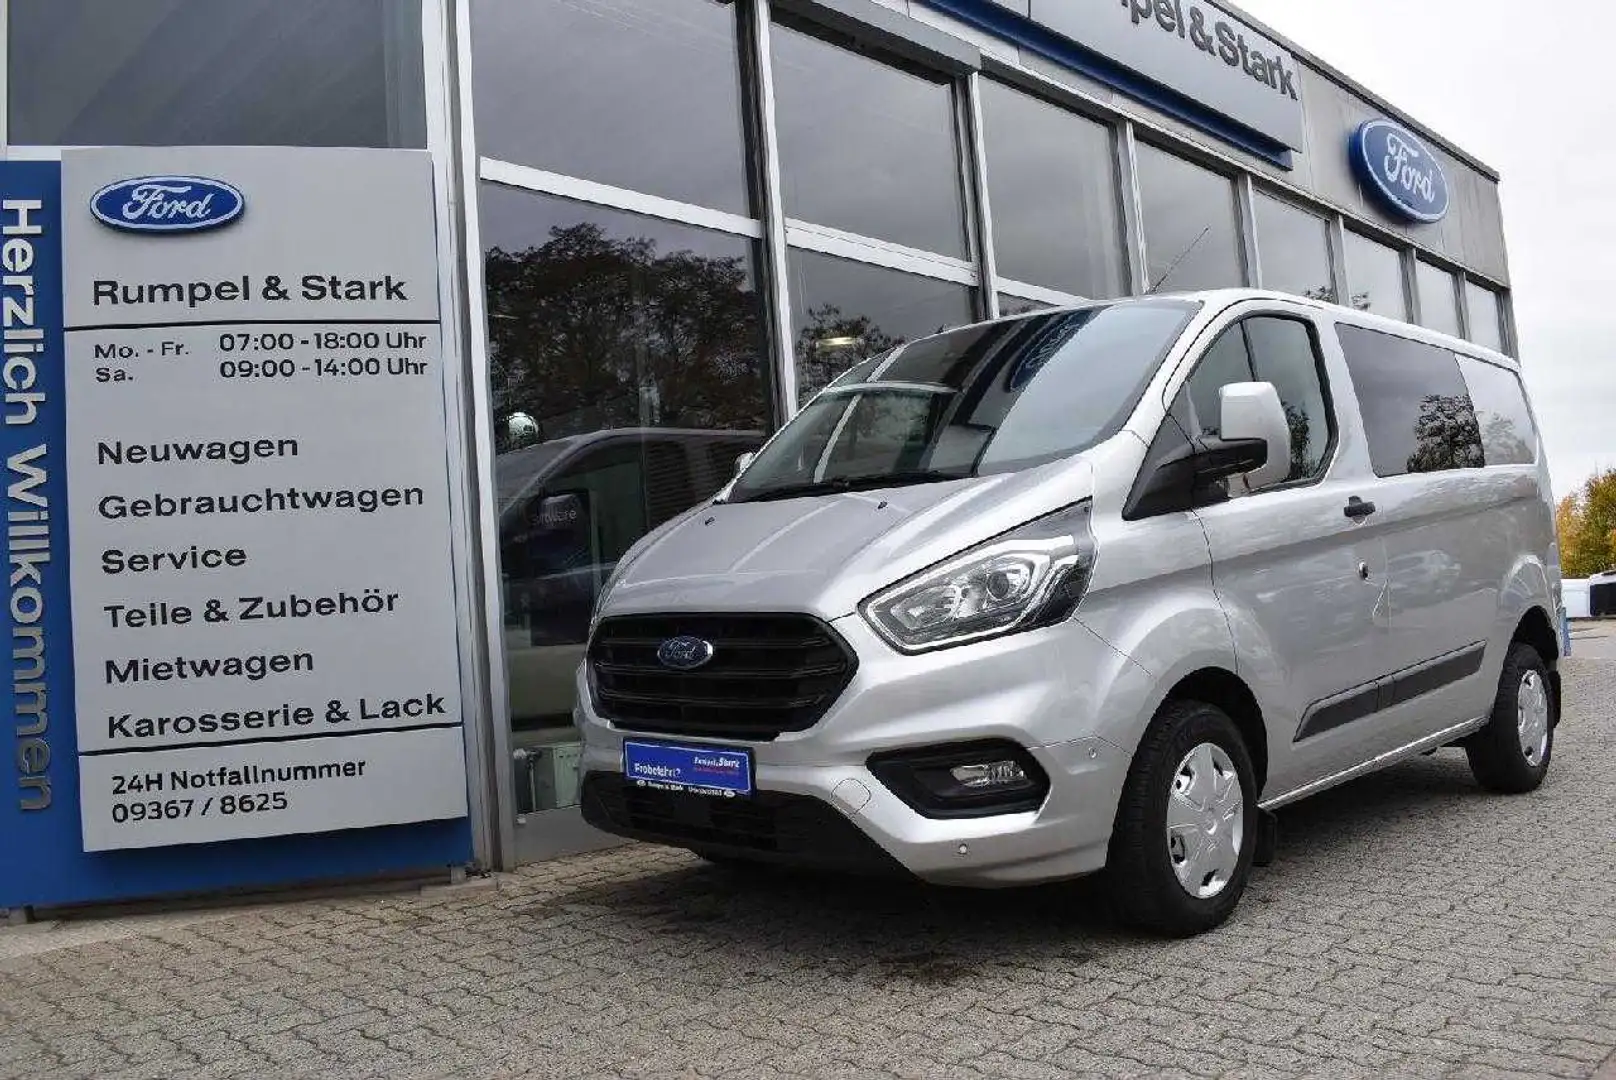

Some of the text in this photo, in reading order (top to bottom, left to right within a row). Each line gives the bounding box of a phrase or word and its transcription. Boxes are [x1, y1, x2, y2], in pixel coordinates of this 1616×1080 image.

[1383, 133, 1436, 203] Ford
[123, 183, 214, 220] Ford
[94, 276, 408, 308] Rumpel & Stark
[95, 344, 138, 358] Mo.
[162, 342, 188, 356] Fr.
[386, 332, 426, 348] Uhr
[96, 367, 133, 382] Sa.
[388, 358, 427, 375] Uhr
[98, 440, 297, 464] Neuwagen
[2, 199, 52, 811] Herzlich Willkommen
[99, 488, 422, 519] Gebrauchtwagen
[102, 546, 246, 574] Service
[104, 589, 398, 627] Teile & Zubehör
[105, 653, 313, 685] Mietwagen
[109, 693, 446, 738] Karosserie & Lack
[112, 760, 365, 795] 24H Notfallnummer
[112, 799, 194, 823] 09367
[220, 791, 287, 814] 8625
